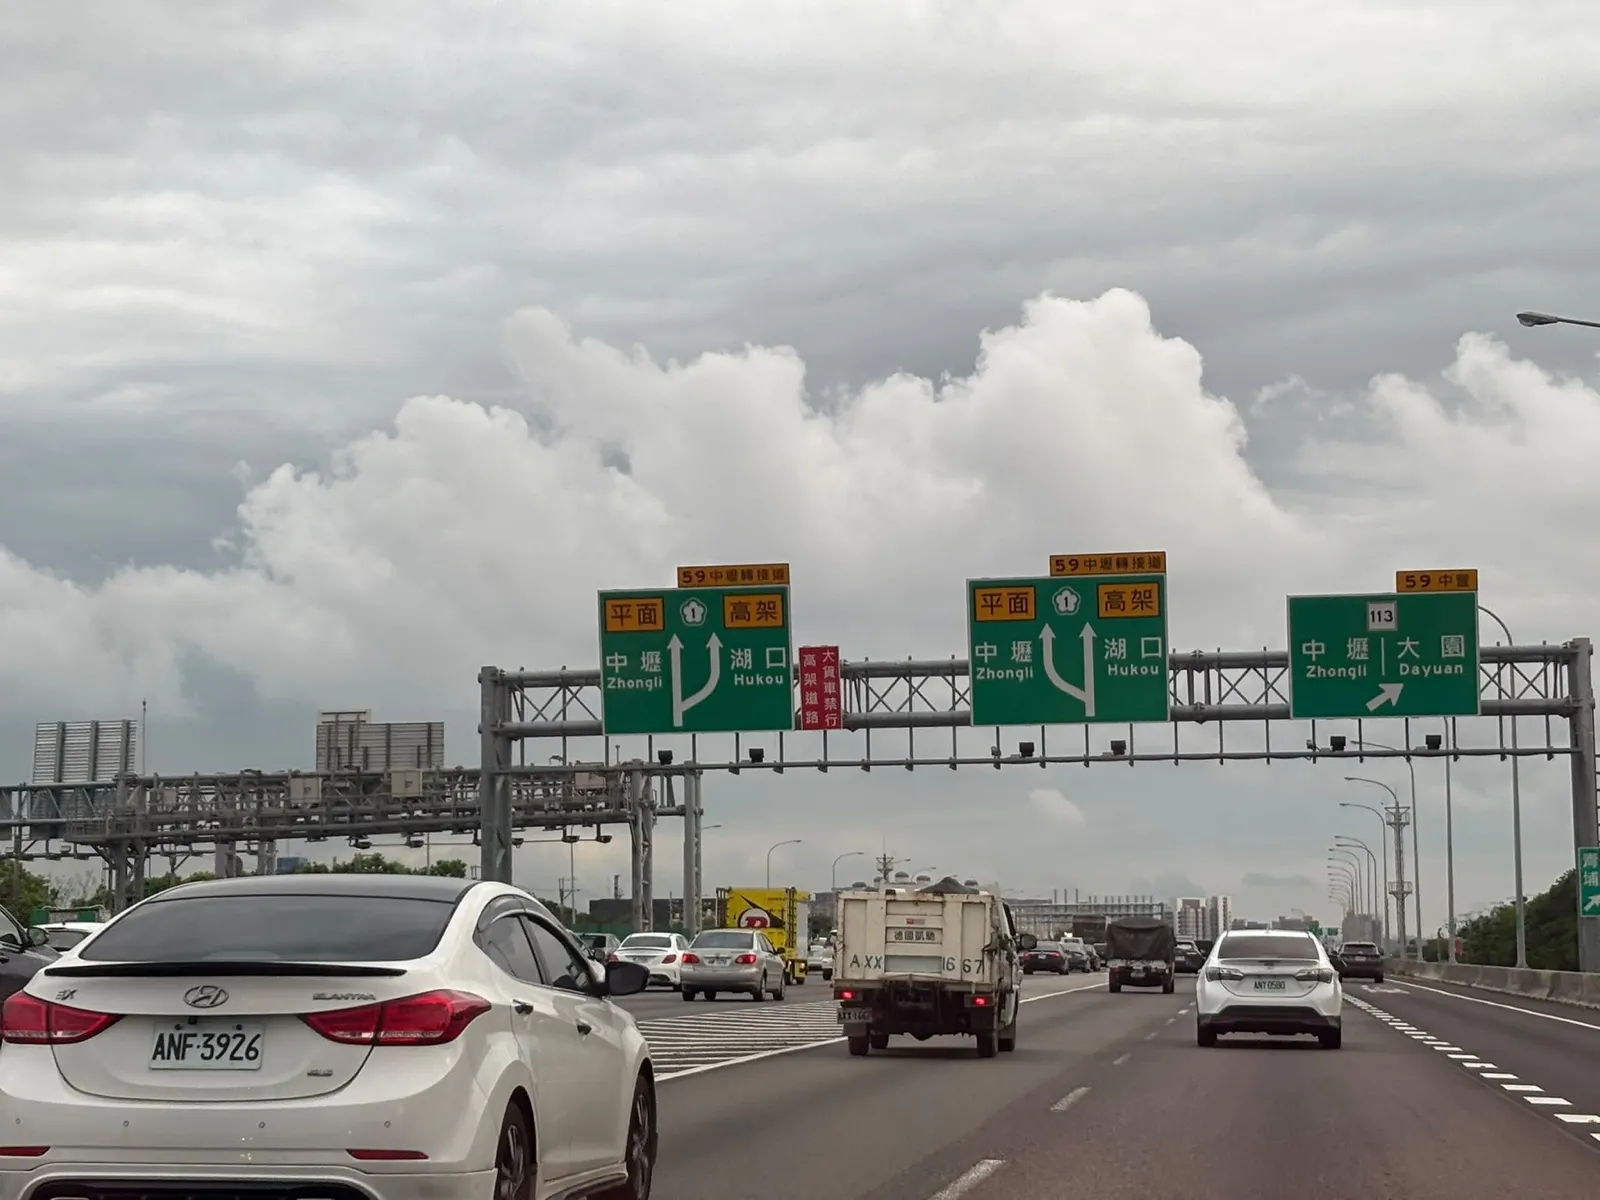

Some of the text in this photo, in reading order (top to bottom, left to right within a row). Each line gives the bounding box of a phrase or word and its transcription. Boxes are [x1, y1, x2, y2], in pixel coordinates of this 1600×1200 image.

[1405, 574, 1431, 588] 59
[730, 600, 778, 622] 高架
[981, 592, 1029, 616] 平面
[1104, 588, 1154, 612] 高架
[611, 602, 659, 627] 平面
[1369, 609, 1394, 623] 113
[730, 646, 786, 670] 湖口
[975, 640, 1033, 664] 中壢
[1104, 636, 1163, 660] 湖口
[1302, 637, 1369, 661] 中壢
[1397, 635, 1465, 660] 大園
[605, 651, 663, 674] 中壢
[976, 666, 1034, 682] Zhongli
[1108, 664, 1159, 676] Hukou
[1306, 665, 1367, 680] Zhongli
[1399, 663, 1464, 677] Dayuan
[606, 676, 663, 691] Zhongli
[734, 674, 784, 686] Hukou
[803, 654, 819, 724] 高架道路
[152, 1032, 261, 1061] ANF-3926
